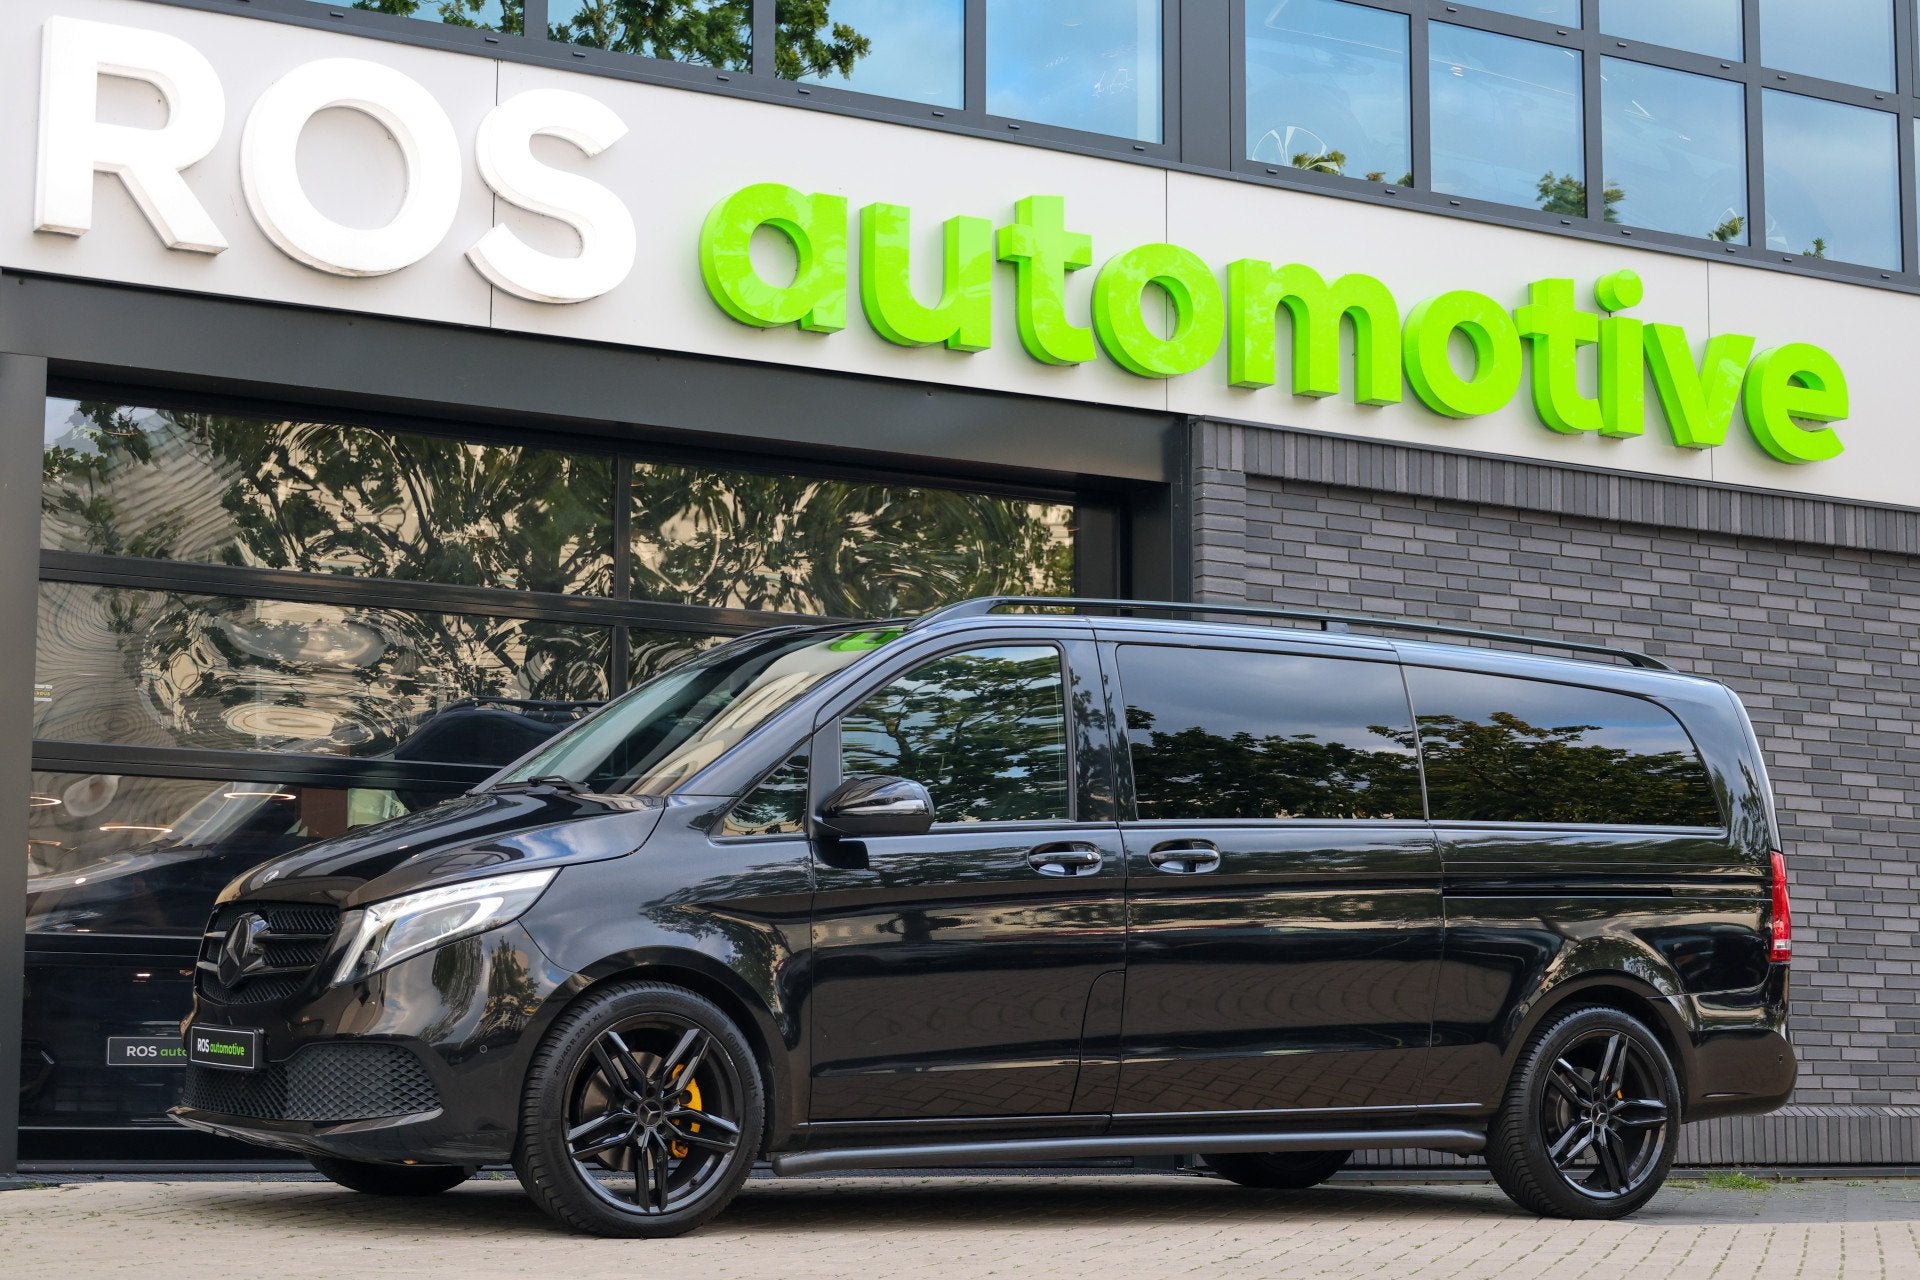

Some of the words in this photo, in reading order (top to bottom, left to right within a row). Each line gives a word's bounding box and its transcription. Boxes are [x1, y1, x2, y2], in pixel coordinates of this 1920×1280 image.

[33, 14, 637, 305] ROS
[699, 183, 1849, 463] automotive
[126, 1045, 158, 1057] ROS
[197, 1038, 210, 1053] ROS
[210, 1042, 246, 1056] automotive
